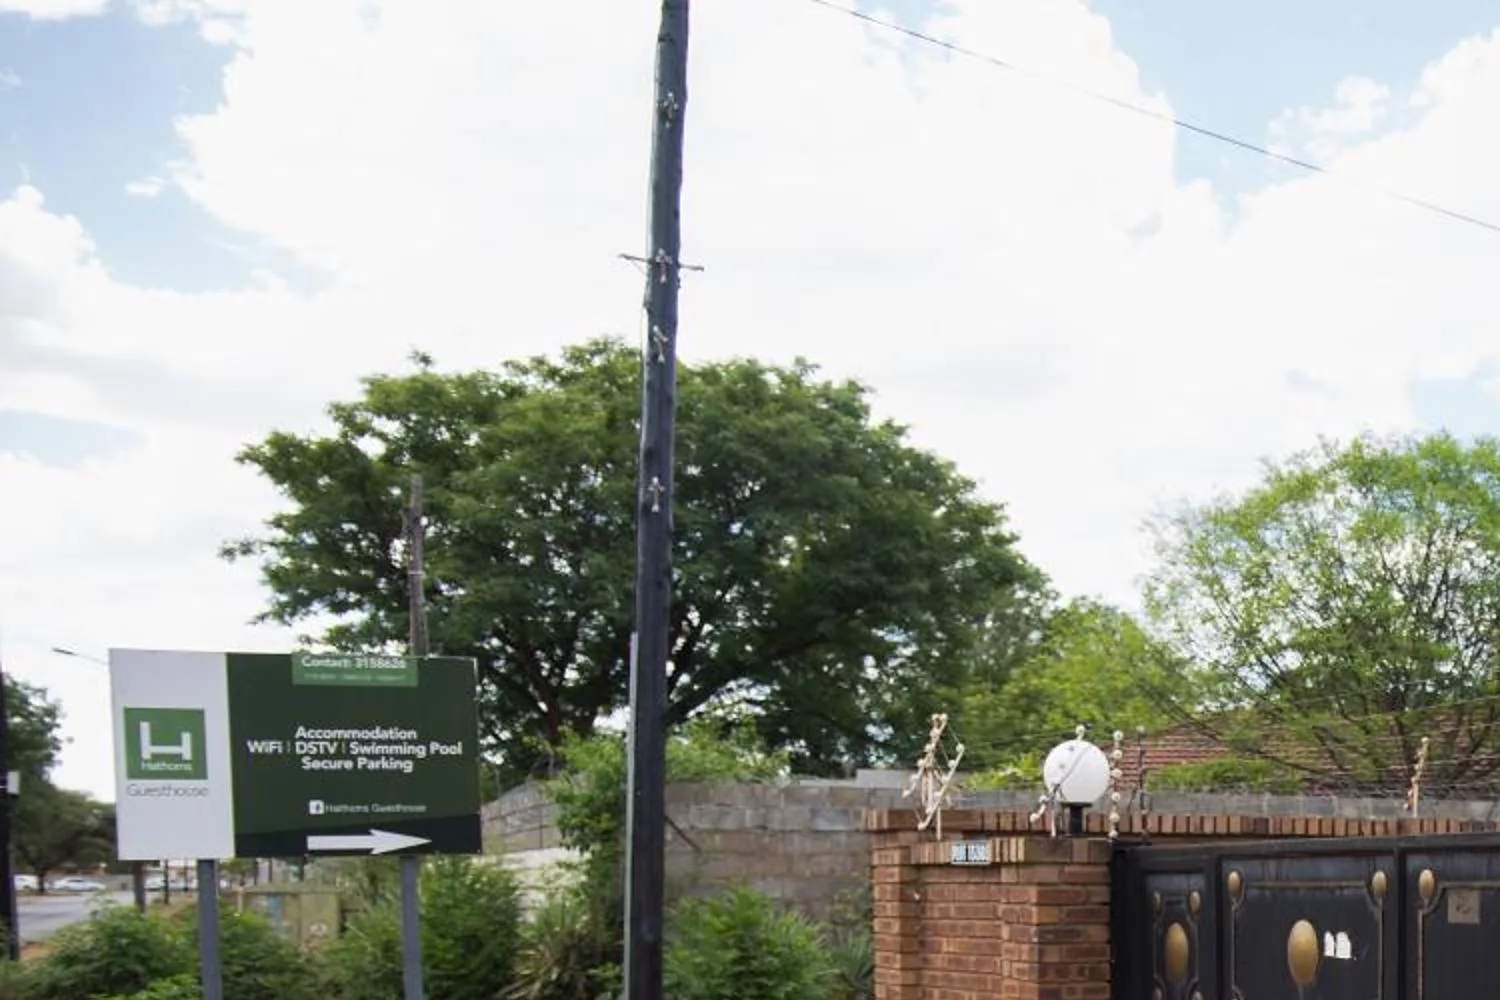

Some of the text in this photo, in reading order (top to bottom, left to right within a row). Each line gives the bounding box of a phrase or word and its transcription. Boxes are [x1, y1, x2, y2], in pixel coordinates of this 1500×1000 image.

[295, 726, 417, 740] Accommodation
[247, 740, 282, 754] WiFi
[295, 741, 339, 755] DSTV
[349, 741, 427, 758] Swimming
[429, 742, 463, 755] Pool
[301, 756, 413, 773] Secure Parking
